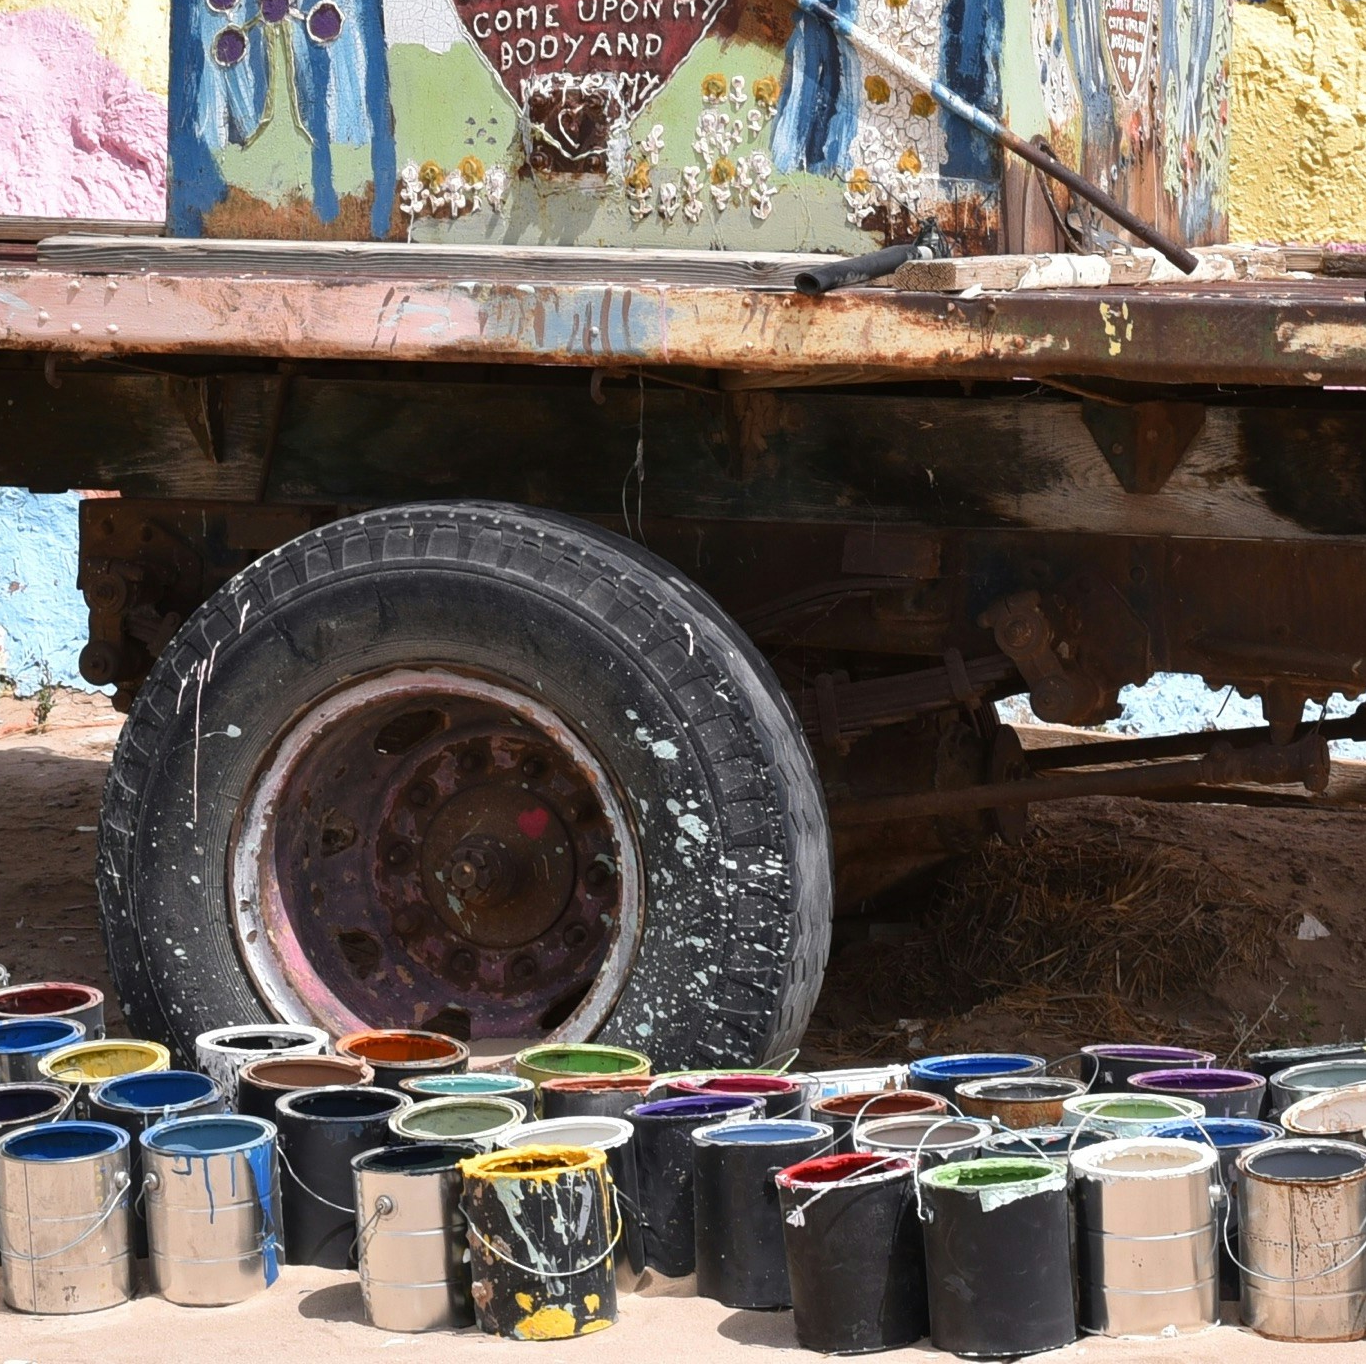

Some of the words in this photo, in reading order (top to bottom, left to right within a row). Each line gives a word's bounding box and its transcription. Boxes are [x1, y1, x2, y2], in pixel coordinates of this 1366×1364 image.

[472, 3, 561, 39] COME
[499, 32, 585, 71] BODY
[589, 32, 664, 58] AND
[617, 70, 661, 103] MY
